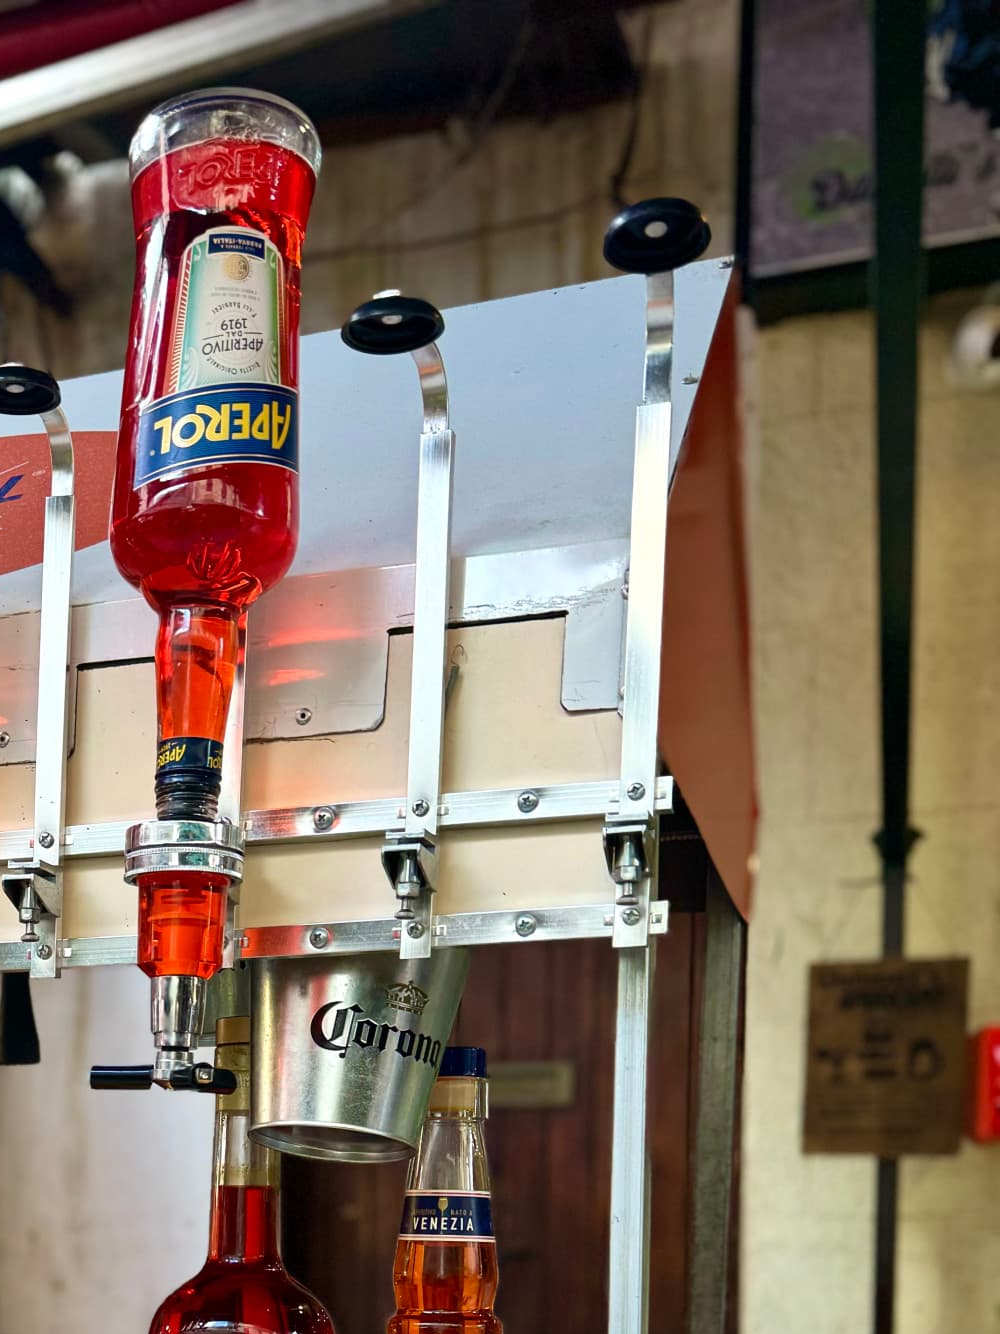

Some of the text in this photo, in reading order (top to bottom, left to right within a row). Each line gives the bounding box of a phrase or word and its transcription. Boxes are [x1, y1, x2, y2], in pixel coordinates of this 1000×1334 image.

[220, 318, 248, 331] 1919
[202, 338, 264, 356] APERITIVO
[154, 401, 291, 454] APEROL
[413, 1217, 474, 1232] VENEZIA
